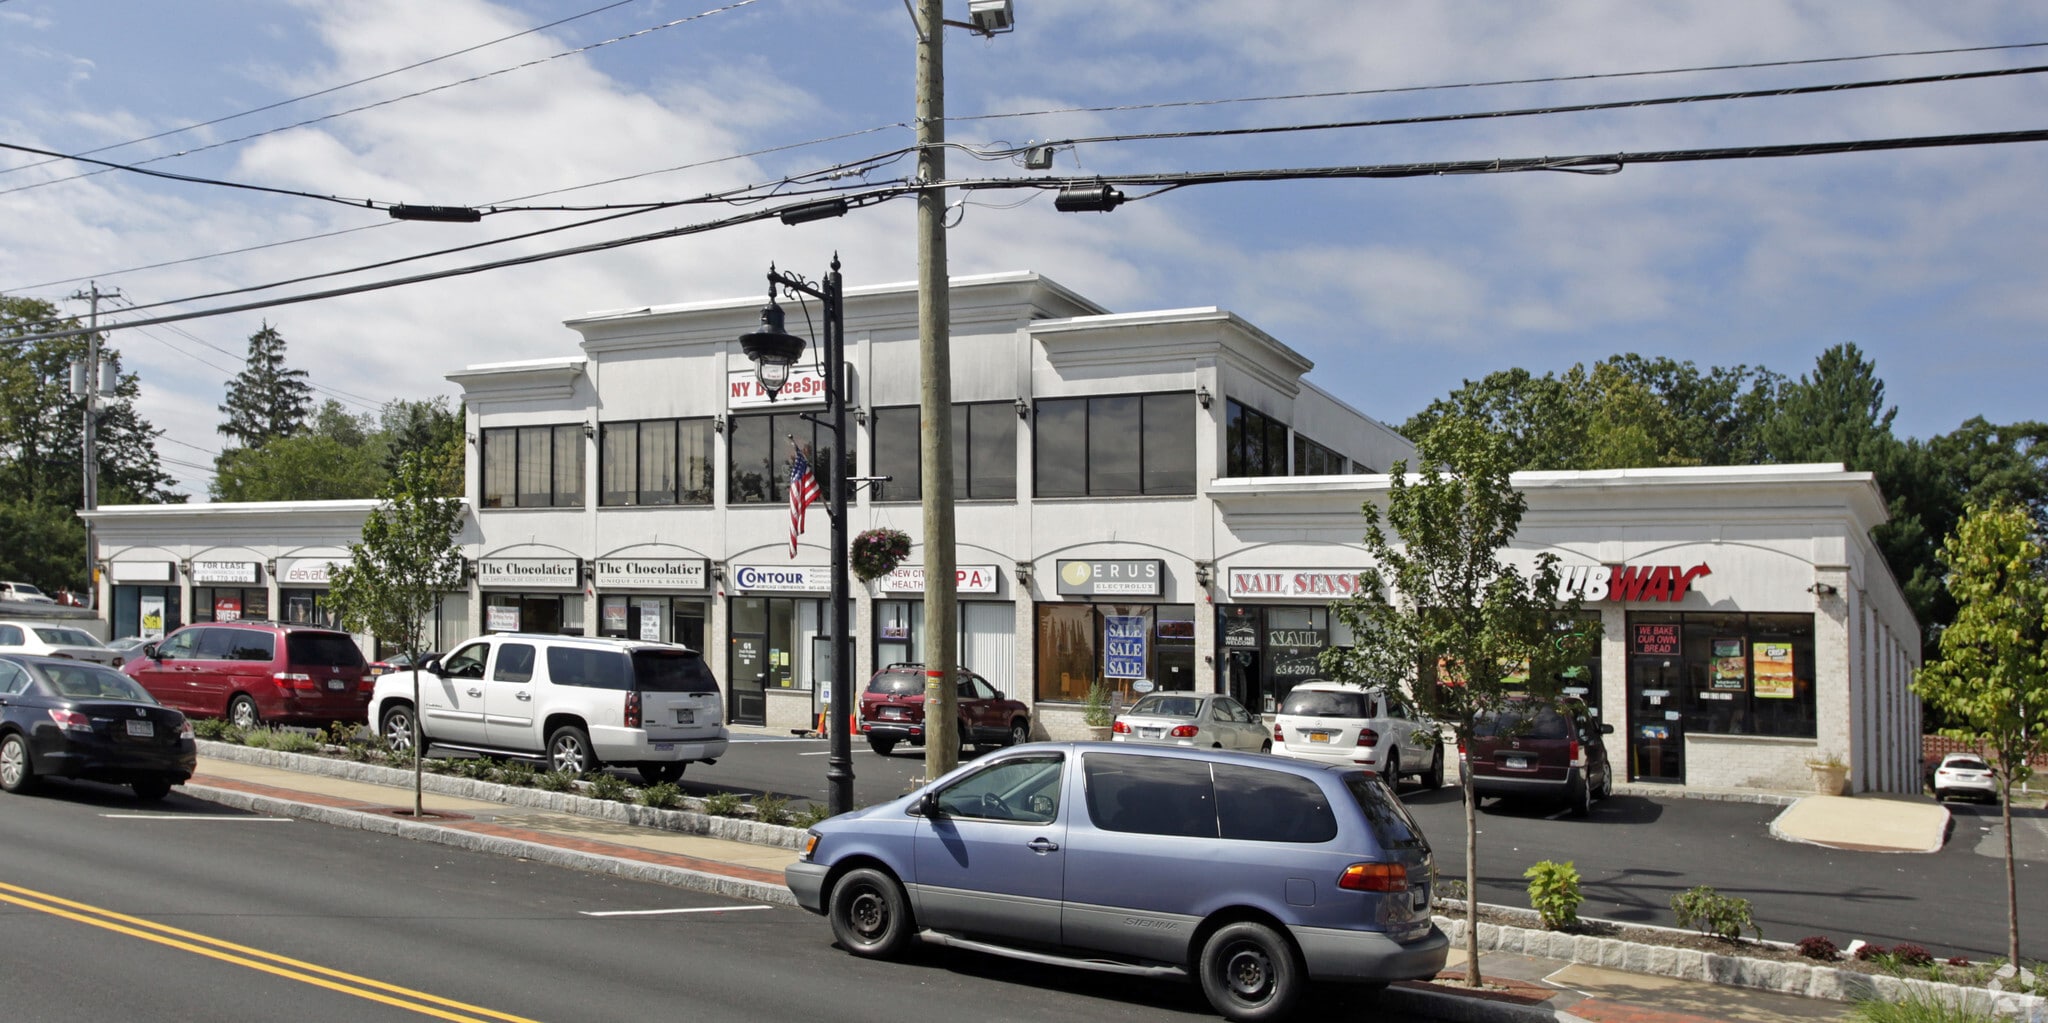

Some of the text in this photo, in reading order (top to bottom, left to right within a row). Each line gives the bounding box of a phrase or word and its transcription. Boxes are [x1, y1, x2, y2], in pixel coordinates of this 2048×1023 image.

[731, 382, 750, 397] NY
[481, 563, 574, 575] The Chocolatier
[598, 562, 702, 575] The Chocolatier
[892, 569, 911, 578] NEW
[1076, 563, 1156, 578] AERUS
[737, 567, 804, 588] CONTOUR
[955, 570, 983, 587] PA
[1234, 573, 1288, 594] NAIL
[1532, 563, 1712, 602] UBWAY
[892, 580, 924, 589] HEALTH
[216, 610, 241, 621] SWEET
[1108, 624, 1142, 638] SALE
[1639, 626, 1674, 635] WE BAKE
[1269, 631, 1322, 648] NAIL
[1638, 635, 1677, 644] OUR OWN
[1108, 643, 1142, 656] SALE
[1643, 644, 1671, 653] BREAD
[1108, 662, 1142, 676] SALE
[1275, 665, 1316, 675] 634-2976
[1123, 917, 1178, 930] SIENNA
